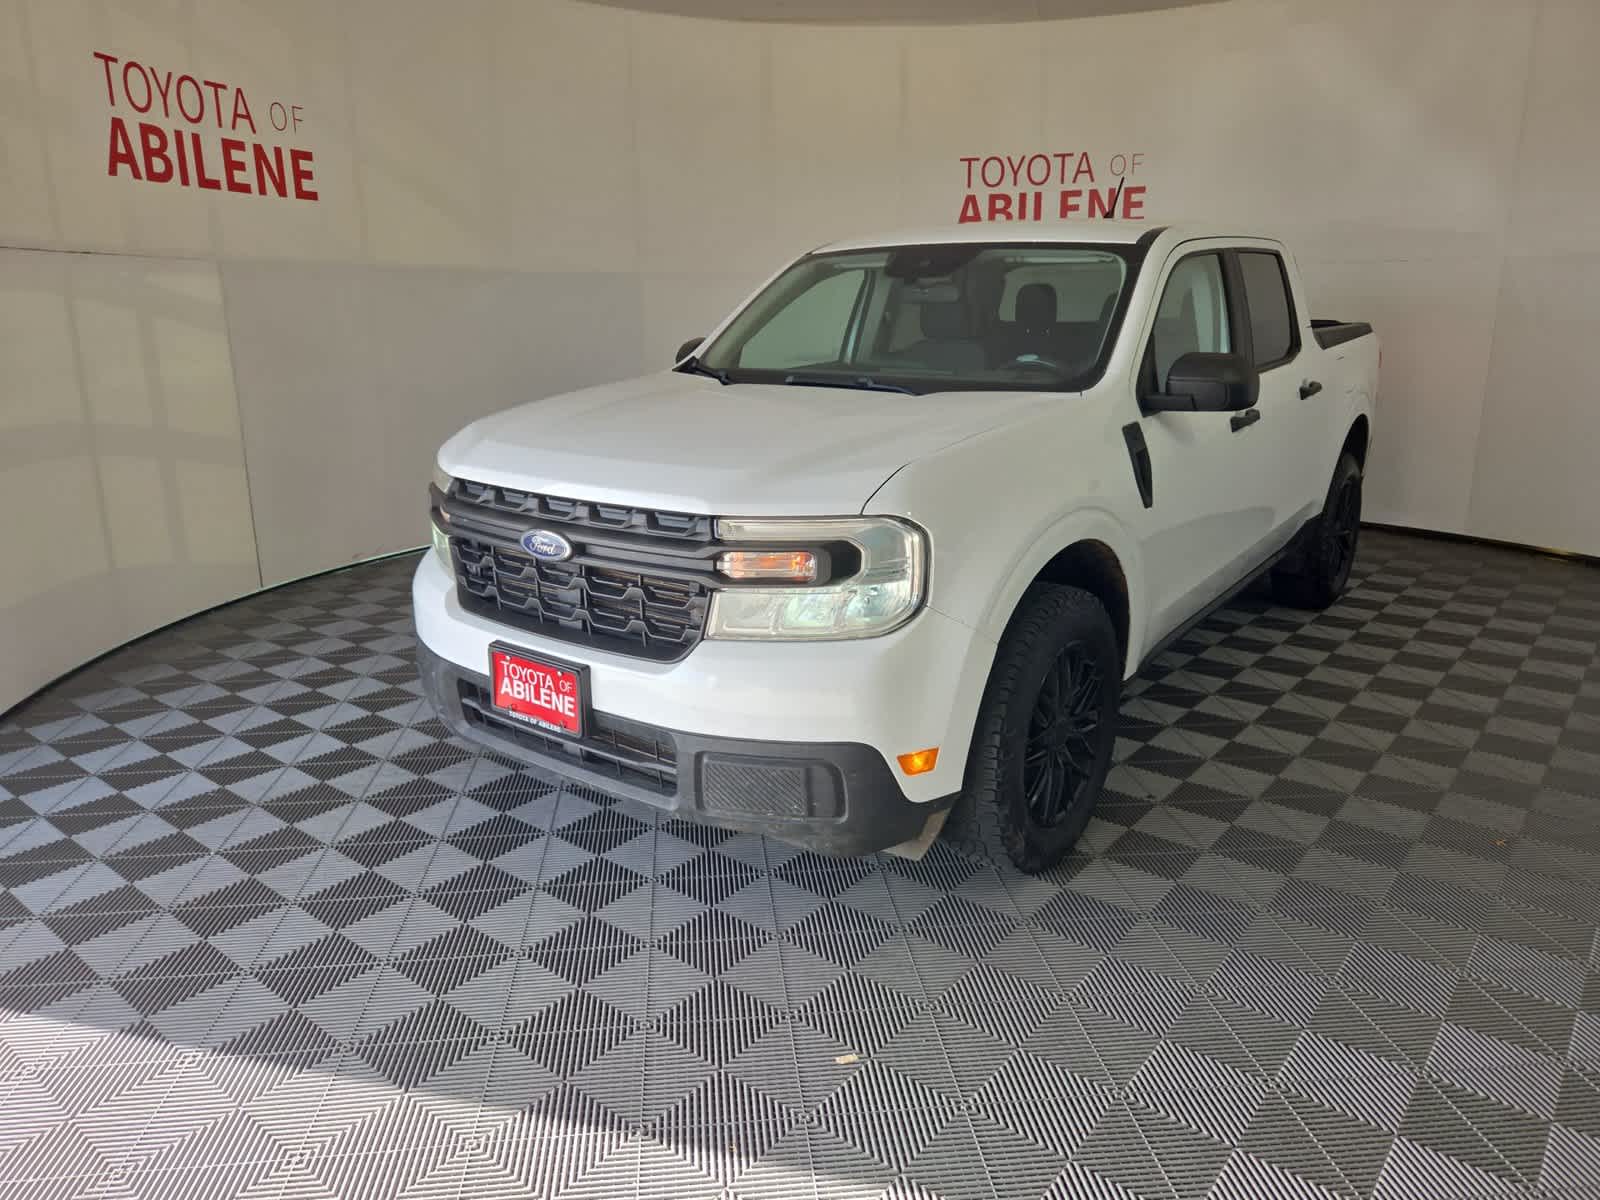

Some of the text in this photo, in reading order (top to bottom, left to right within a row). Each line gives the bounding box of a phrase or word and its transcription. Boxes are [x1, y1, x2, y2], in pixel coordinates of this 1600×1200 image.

[93, 51, 305, 135] TOYOTA OF
[108, 116, 319, 201] ABILENE
[959, 151, 1145, 188] TOYOTA OF
[529, 535, 556, 555] Ford
[500, 661, 573, 693] TOYOTA OF
[501, 677, 575, 717] ABILENE
